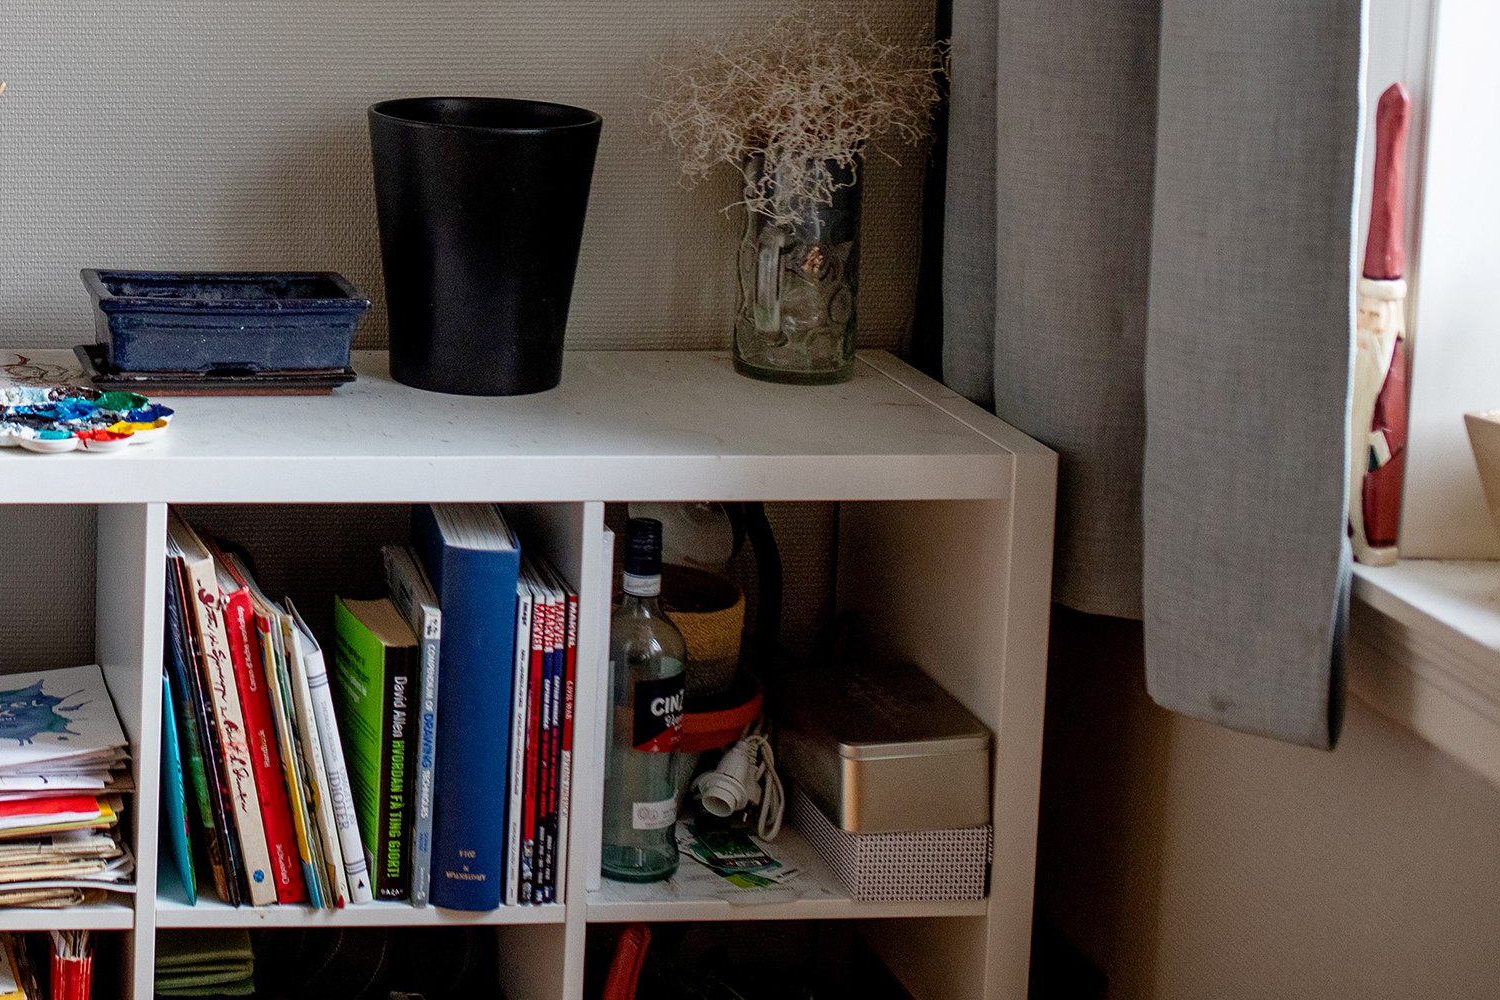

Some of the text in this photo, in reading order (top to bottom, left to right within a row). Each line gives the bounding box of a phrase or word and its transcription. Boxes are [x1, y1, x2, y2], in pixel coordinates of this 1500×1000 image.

[532, 602, 544, 651] MARVEL
[543, 605, 555, 653] MARVEL
[554, 601, 565, 649] MARVEL
[567, 600, 578, 648] MARVEL
[424, 643, 437, 700] COMPENDIUM
[424, 702, 435, 713] OF
[421, 713, 435, 769] DRAWING
[328, 769, 351, 831] IDIOTER
[387, 675, 408, 878] David Allen HVORDAN FÅ TING GJORT!
[420, 769, 431, 819] TECHNIQUES
